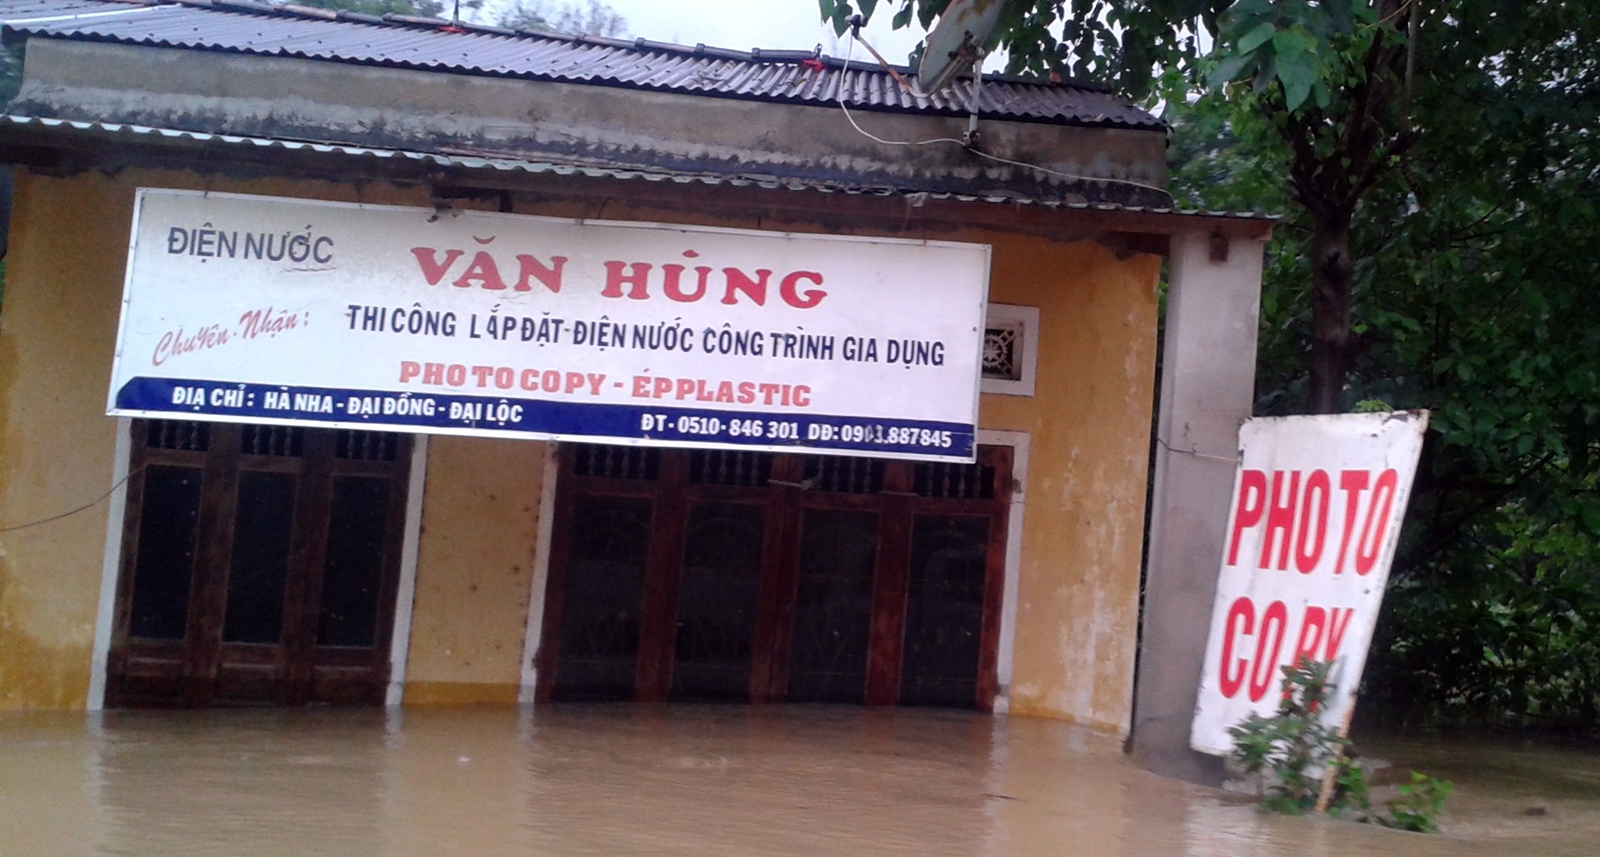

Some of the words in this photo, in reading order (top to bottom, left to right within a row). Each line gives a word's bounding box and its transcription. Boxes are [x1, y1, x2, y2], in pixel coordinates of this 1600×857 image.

[168, 222, 238, 263] ĐIỆN
[244, 224, 334, 264] NƯỚC
[410, 235, 568, 293] VĂN
[347, 304, 386, 332] THI
[391, 302, 456, 337] CÔNG
[469, 303, 517, 340] LẮP
[631, 316, 694, 353] NƯỚC
[702, 322, 764, 357] CÔNG
[770, 325, 835, 360] TRÌNH
[842, 336, 879, 363] GIA
[886, 338, 945, 369] DỤNG
[486, 399, 523, 426] LỘC
[1227, 468, 1398, 576] PHOTO
